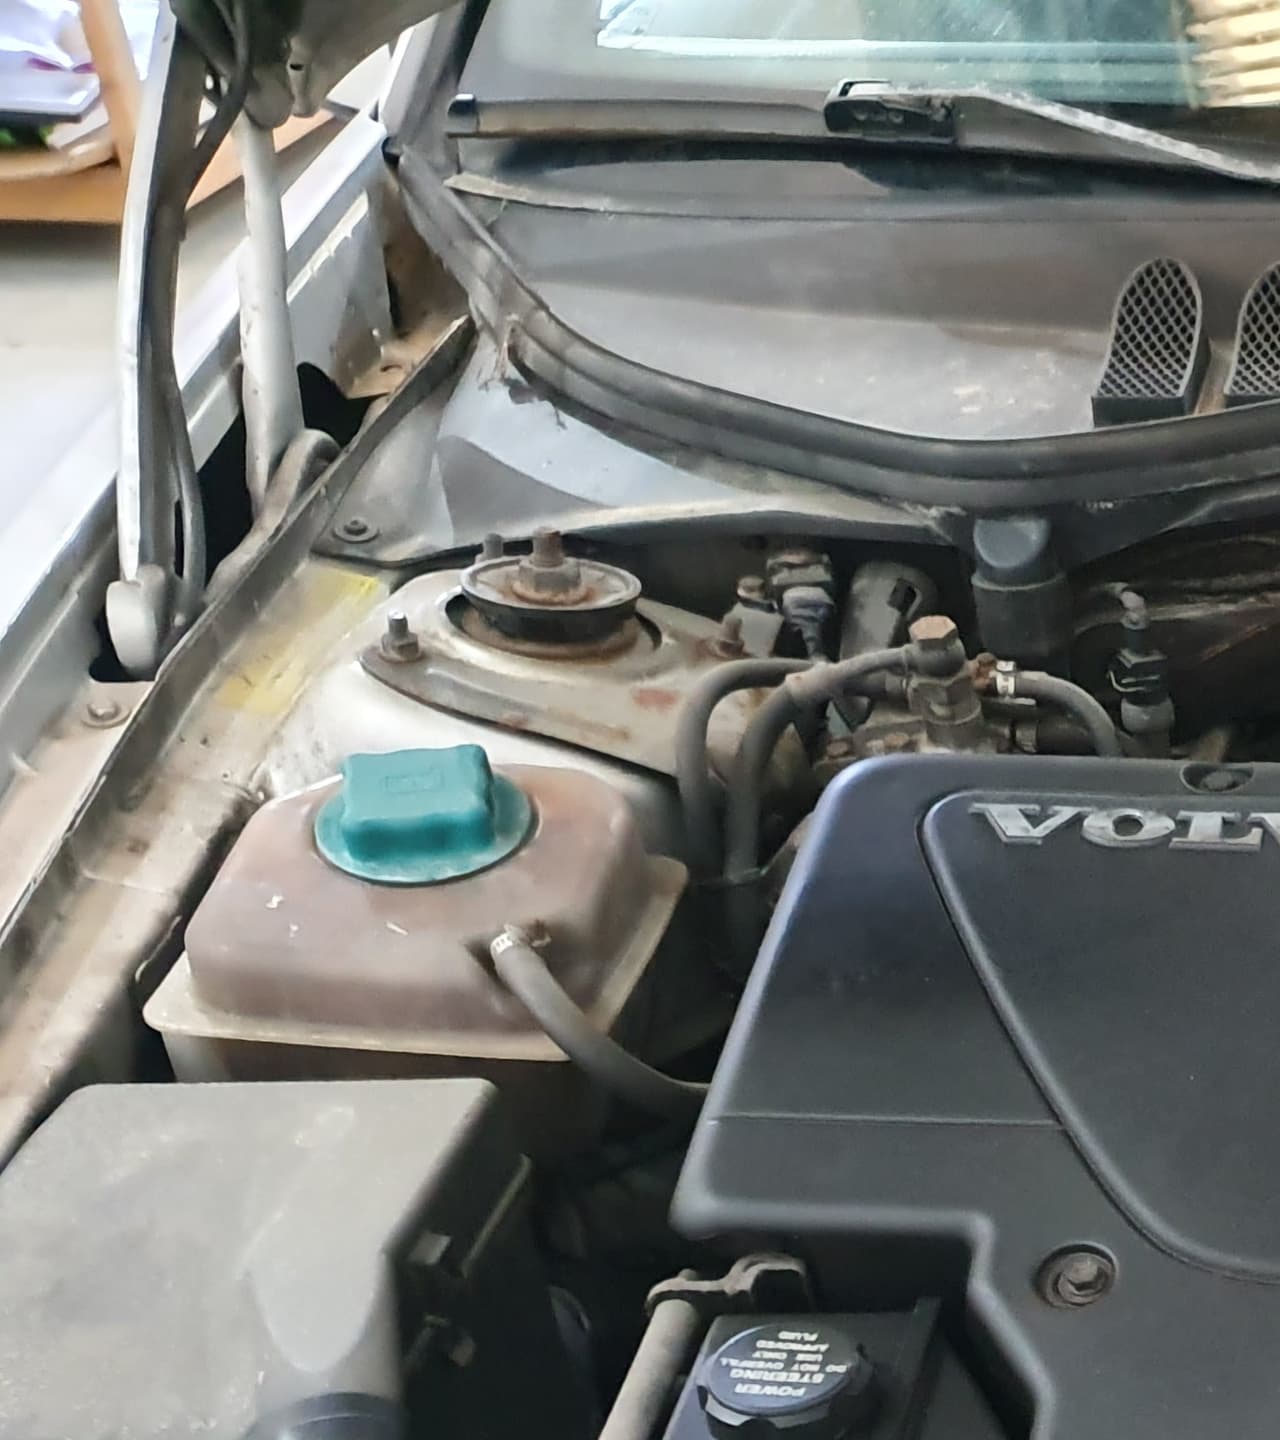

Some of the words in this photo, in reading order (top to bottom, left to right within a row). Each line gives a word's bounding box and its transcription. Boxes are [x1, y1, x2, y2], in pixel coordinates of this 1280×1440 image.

[777, 1330, 818, 1341] FLUID
[756, 1340, 829, 1351] APPROVED
[751, 1350, 787, 1360] ONLY
[795, 1352, 823, 1362] USE
[721, 1357, 784, 1369] OVERFILL
[792, 1363, 820, 1372] NOT
[825, 1364, 848, 1373] DO
[730, 1368, 824, 1382] STEERING
[734, 1384, 806, 1396] POWER
